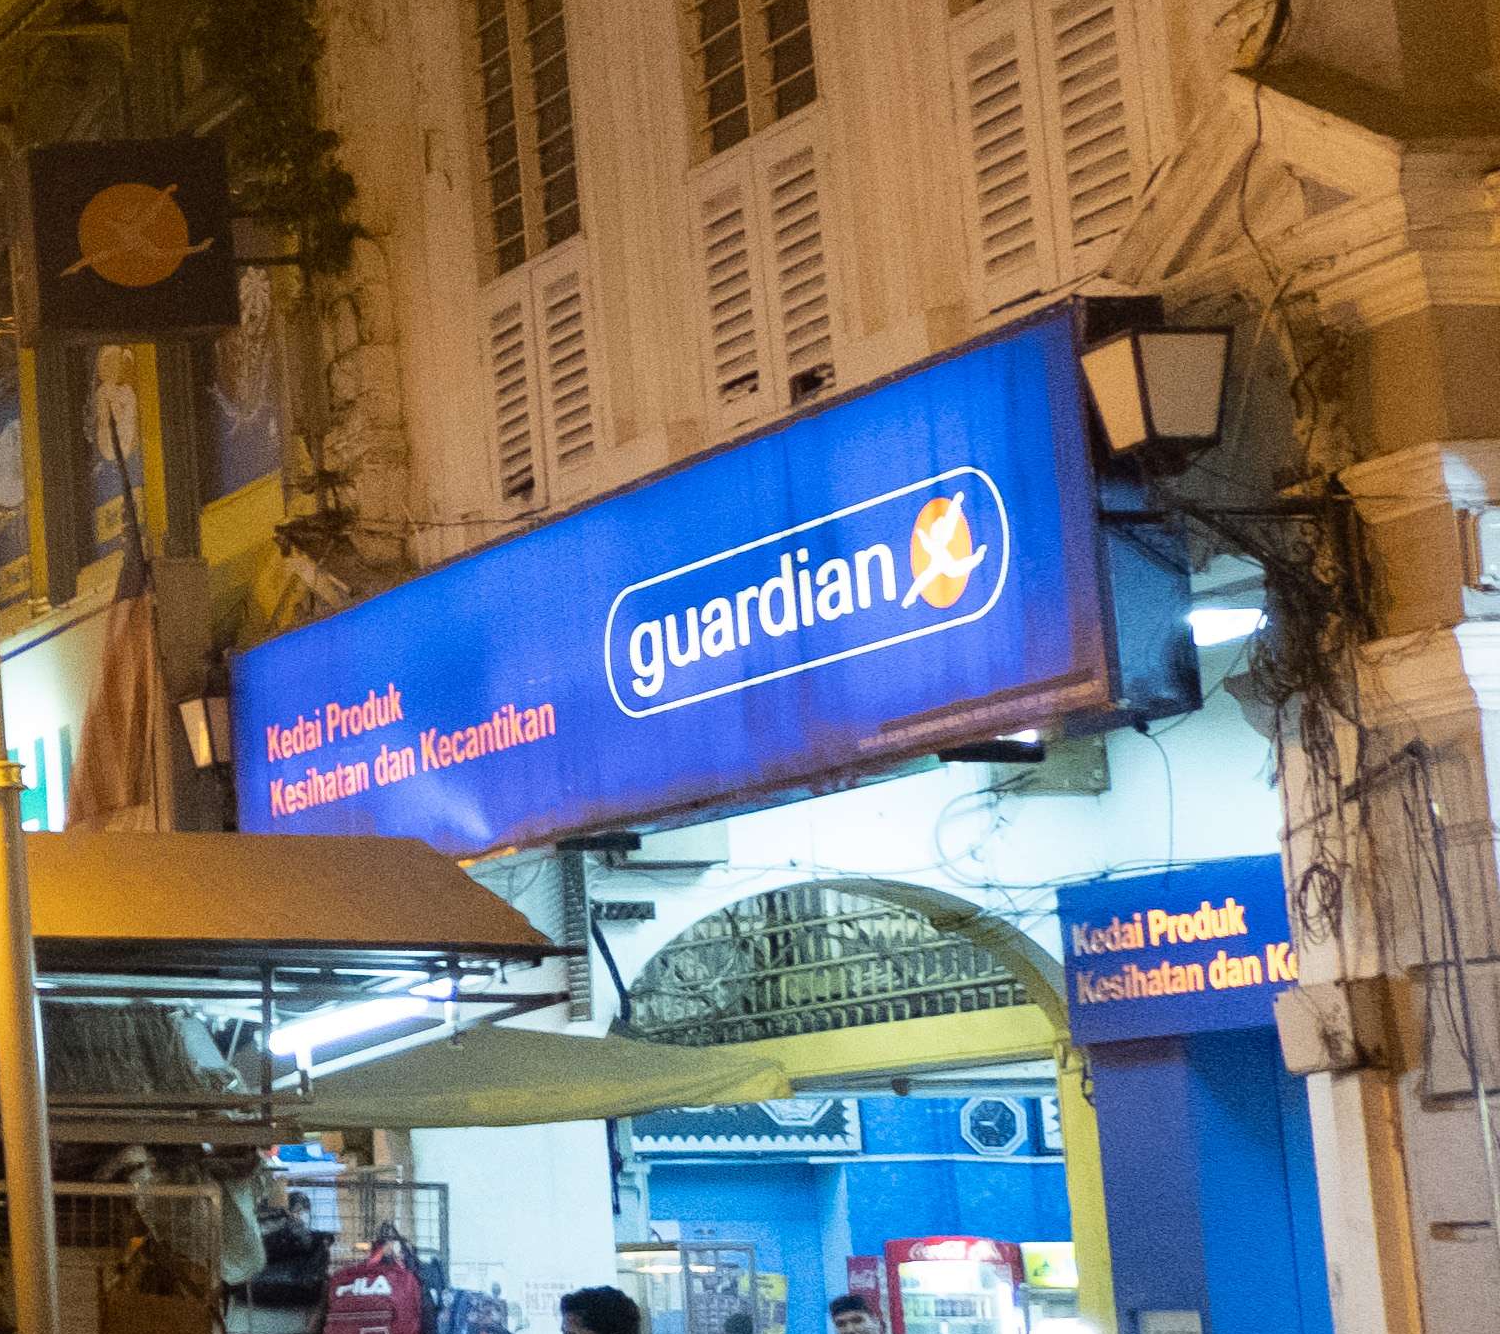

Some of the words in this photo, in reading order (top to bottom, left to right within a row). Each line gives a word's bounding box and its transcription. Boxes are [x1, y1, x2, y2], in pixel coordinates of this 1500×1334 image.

[629, 543, 897, 698] guardian
[266, 708, 323, 763] Kedai
[325, 682, 404, 742] Produk
[270, 758, 370, 818] Kesihatan
[373, 743, 416, 787] dan
[419, 702, 557, 773] Kecantikan
[1071, 912, 1145, 957] Kedai
[1146, 896, 1249, 947] Produk
[1075, 960, 1205, 1005] Kesihatan
[1208, 949, 1263, 990] dan
[334, 1273, 393, 1298] FILA
